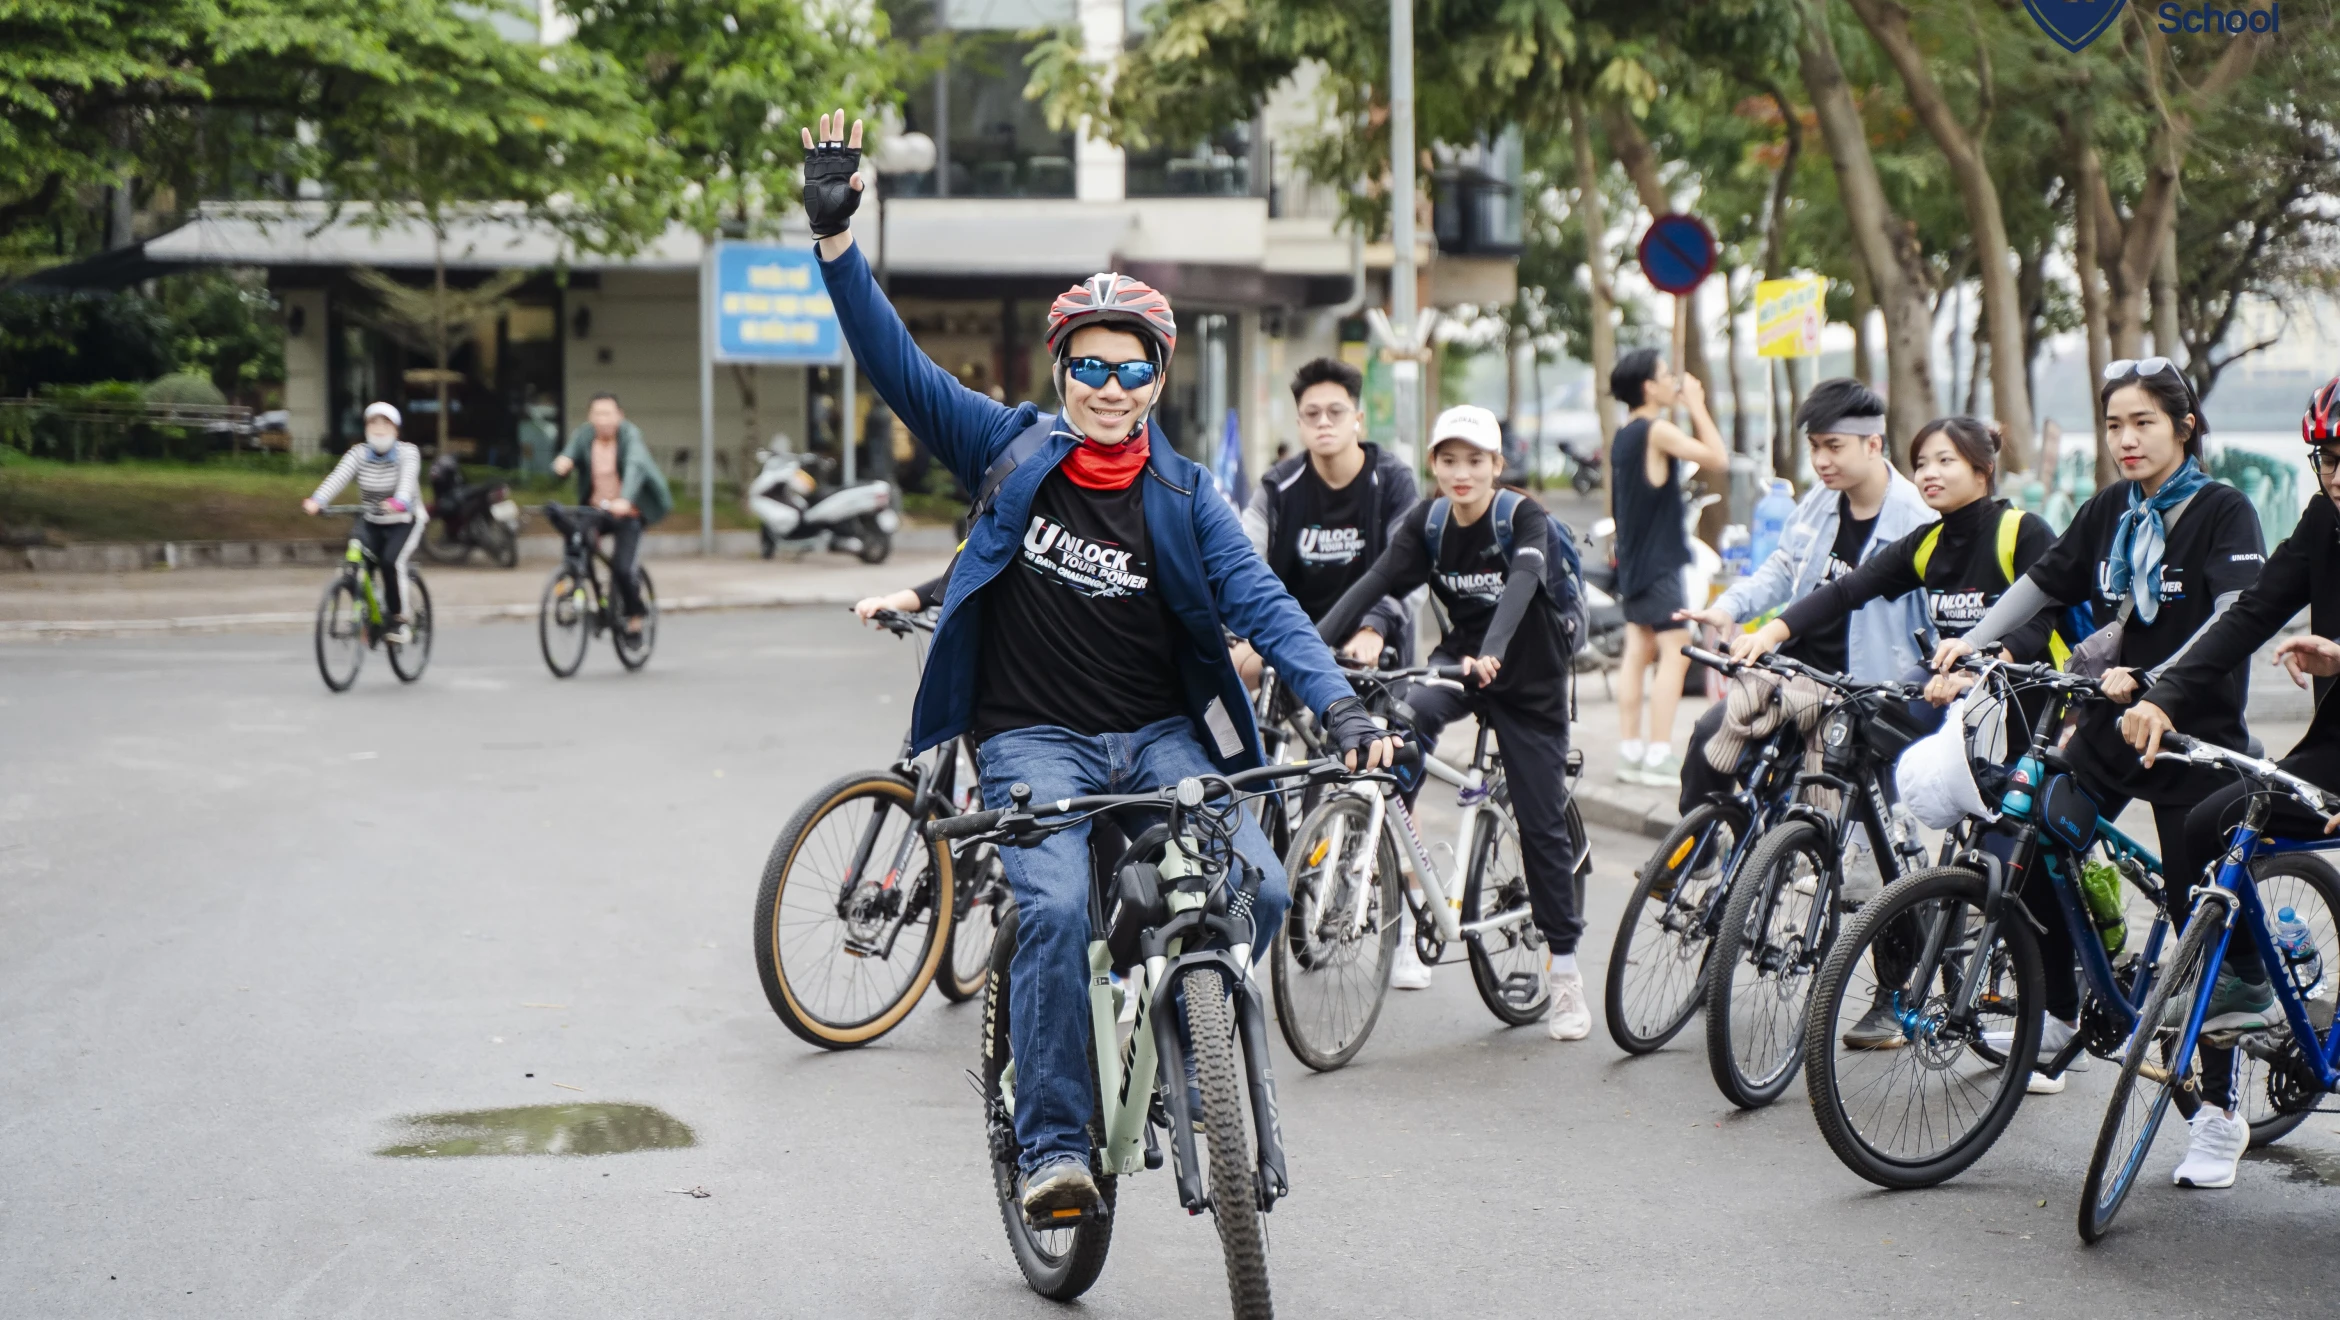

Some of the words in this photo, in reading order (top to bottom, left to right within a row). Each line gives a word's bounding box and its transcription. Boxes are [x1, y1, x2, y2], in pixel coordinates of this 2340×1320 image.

[1024, 515, 1133, 571] UNLOCK
[2231, 553, 2259, 562] UNLOCK
[1061, 552, 1097, 576] YOUR
[1098, 568, 1149, 589] POWER
[1440, 571, 1503, 592] UNLOCK
[1944, 608, 1966, 619] YOUR
[1967, 606, 1992, 619] POW
[985, 970, 1001, 1059] MAXXIS
